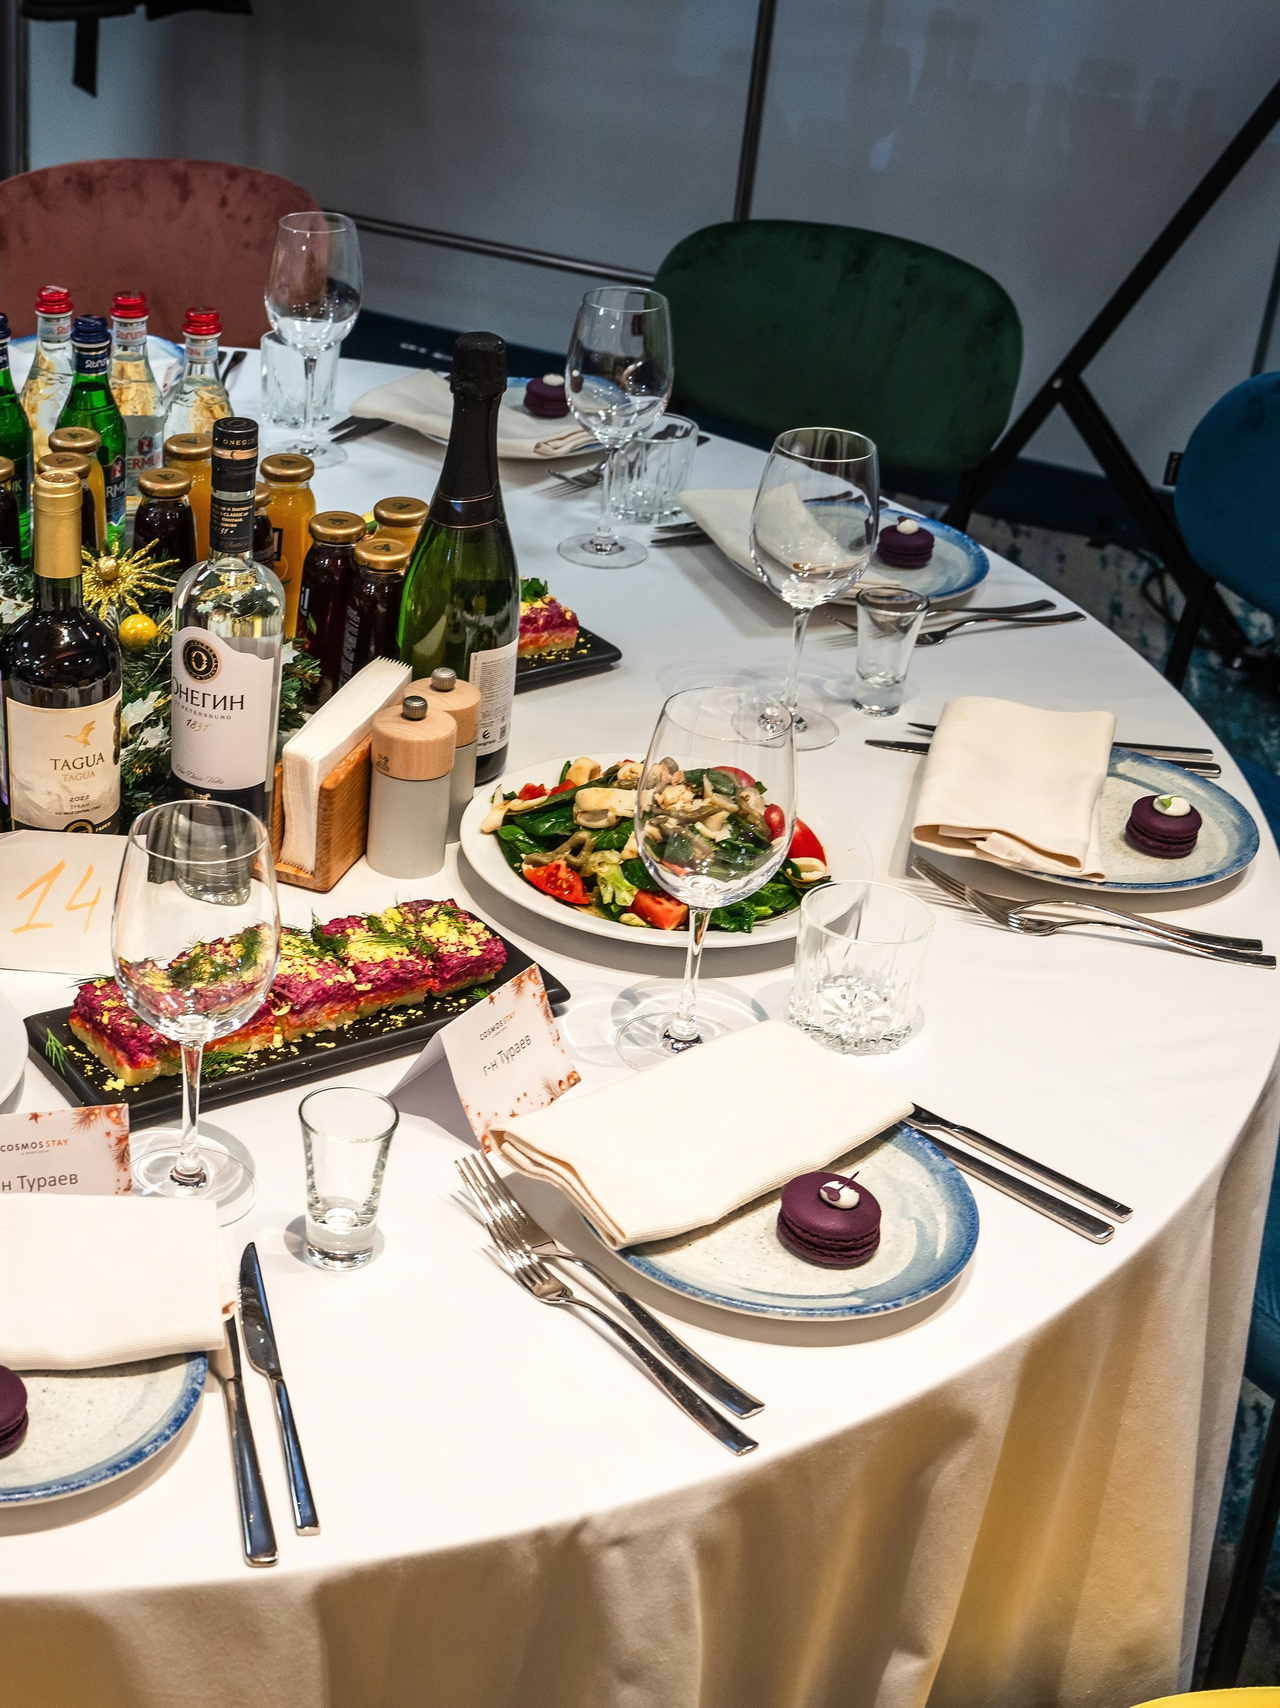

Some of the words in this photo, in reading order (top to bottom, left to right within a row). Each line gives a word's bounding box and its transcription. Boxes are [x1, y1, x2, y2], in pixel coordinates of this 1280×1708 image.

[50, 752, 105, 771] TAGUA
[62, 771, 96, 783] TAGUA
[69, 794, 90, 803] 2022
[11, 860, 102, 934] 14
[479, 1019, 503, 1041] COSMOS
[502, 1011, 516, 1025] STAY
[482, 1058, 499, 1077] г-н
[496, 1034, 532, 1064] Тураев
[0, 1140, 44, 1153] COSMOS
[45, 1138, 69, 1148] STAY
[16, 1173, 79, 1192] Тураев
